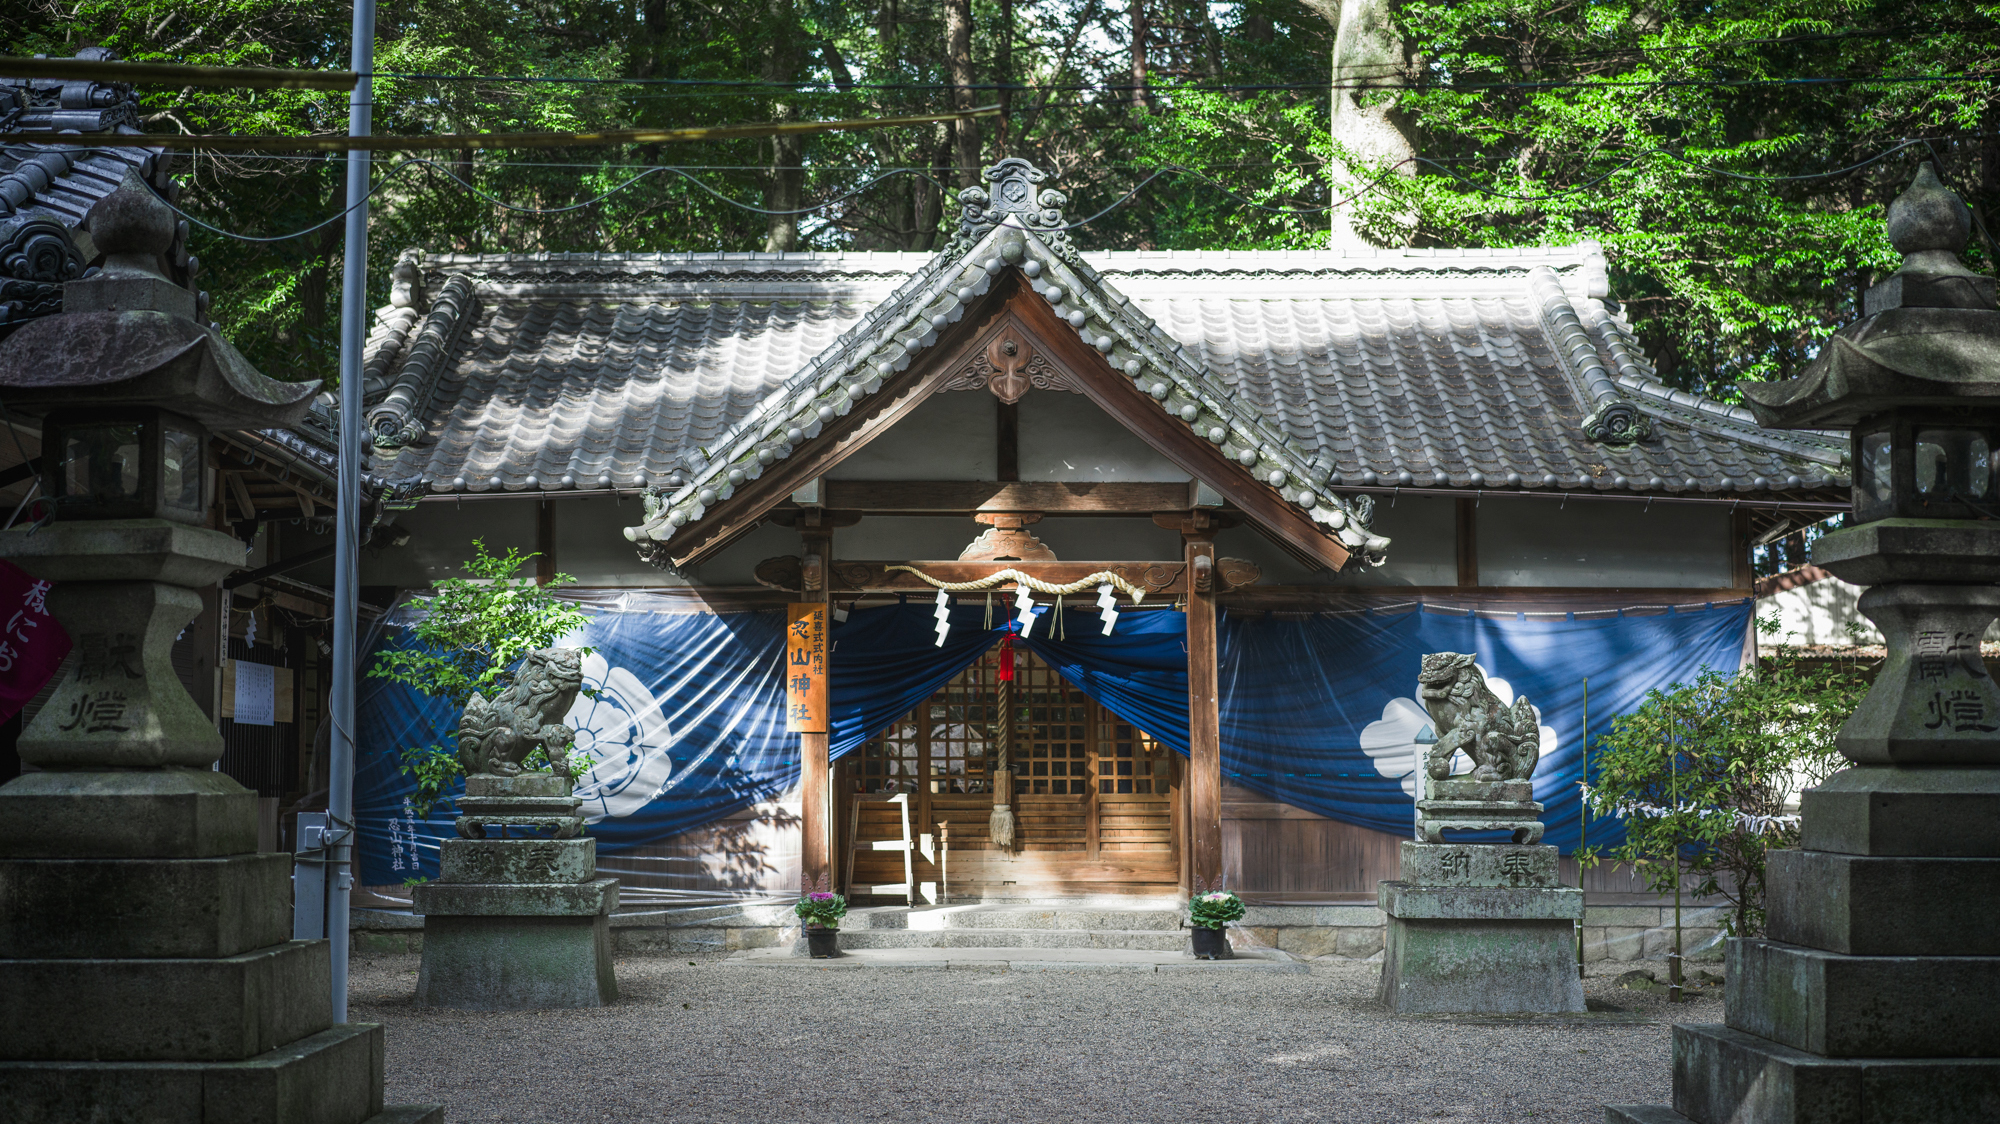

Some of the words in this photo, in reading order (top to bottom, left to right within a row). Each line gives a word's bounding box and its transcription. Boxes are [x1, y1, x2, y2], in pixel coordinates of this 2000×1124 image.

[789, 620, 812, 724] 忍山神社
[813, 610, 824, 675] 延喜式式内社
[388, 817, 406, 871] 忍山神社
